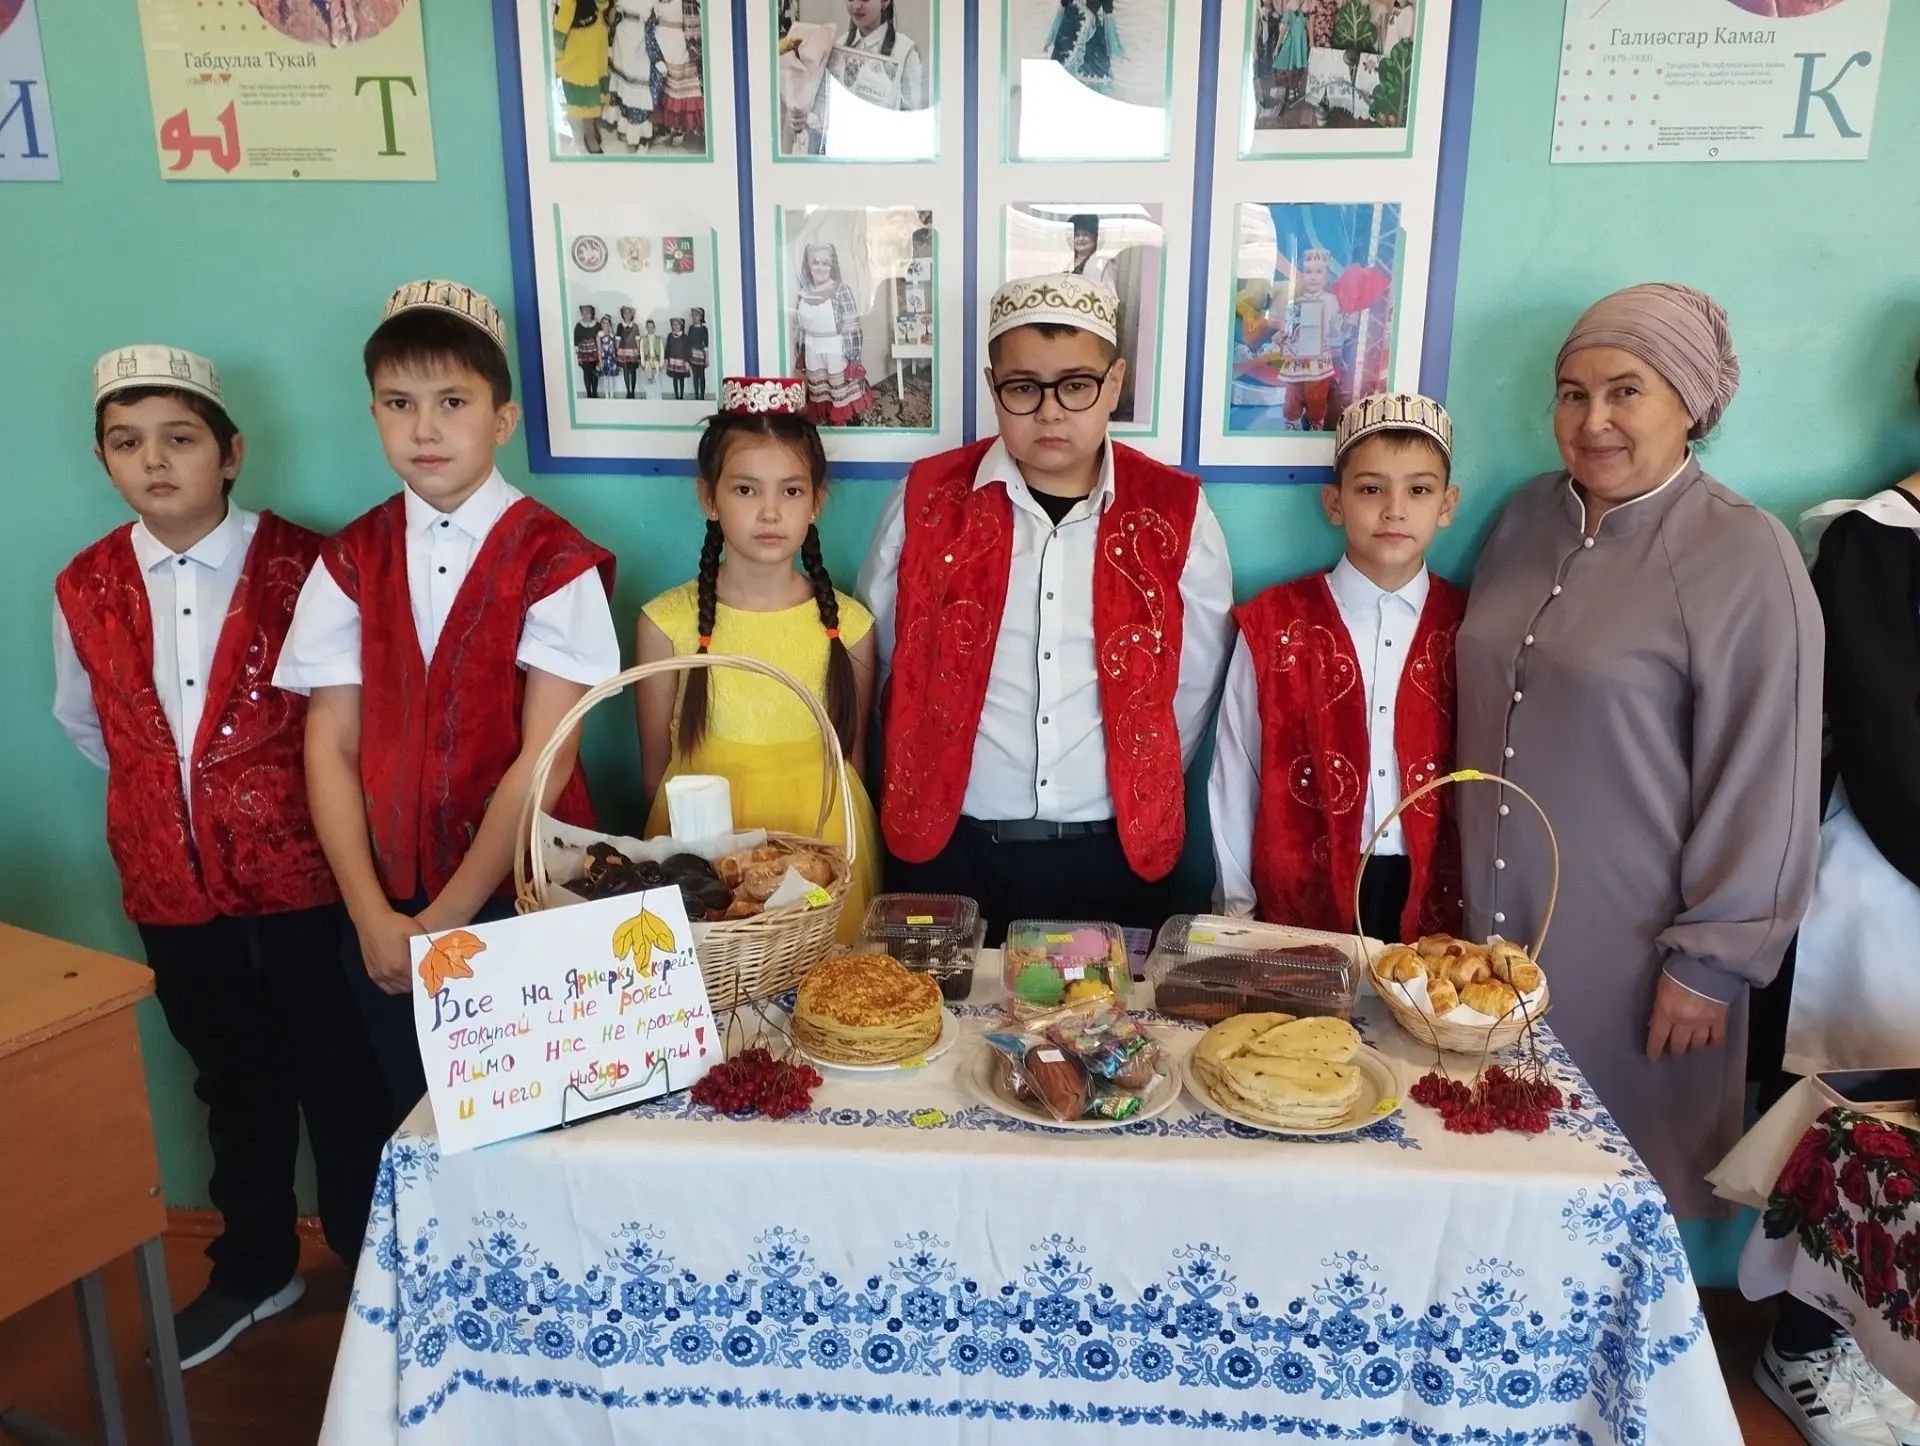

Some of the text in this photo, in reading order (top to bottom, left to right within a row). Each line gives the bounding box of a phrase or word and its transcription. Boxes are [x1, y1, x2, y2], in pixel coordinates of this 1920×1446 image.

[184, 50, 316, 71] Габдулла Тукай
[1610, 27, 1776, 48] Галиәсгар Камал
[354, 76, 417, 156] Т
[1782, 50, 1872, 138] К
[432, 987, 493, 1032] Все
[522, 984, 552, 1006] на
[563, 966, 634, 1005] Ярмарку
[572, 1000, 597, 1020] не
[619, 981, 672, 1016] робей
[447, 1054, 515, 1088] Мимо
[602, 1023, 625, 1042] не
[492, 1081, 541, 1109] чего
[570, 1057, 629, 1092] нибудь
